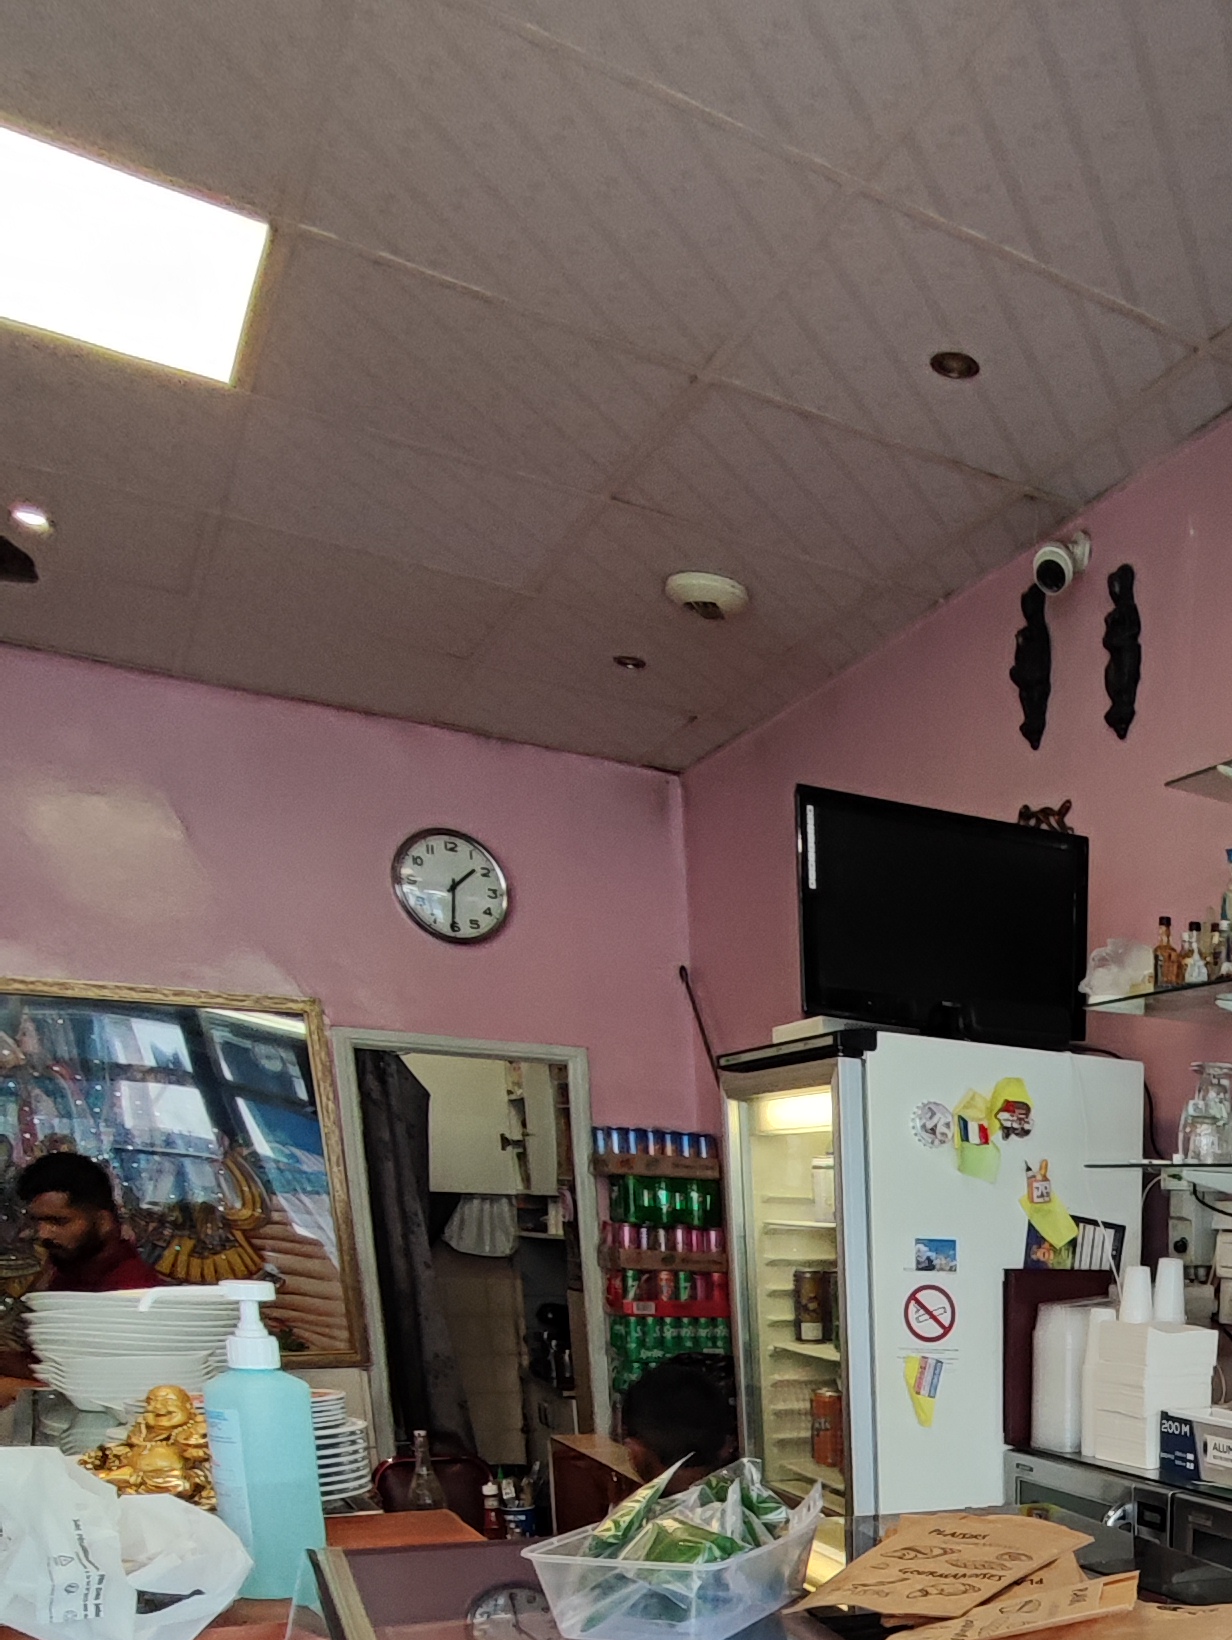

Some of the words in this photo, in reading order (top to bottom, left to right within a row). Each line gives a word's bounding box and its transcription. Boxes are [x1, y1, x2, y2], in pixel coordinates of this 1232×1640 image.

[426, 844, 435, 855] 11
[444, 841, 458, 853] 12
[412, 855, 424, 866] 10
[480, 867, 491, 878] 2
[487, 888, 498, 899] 3
[483, 907, 493, 916] 4
[450, 920, 461, 932] 6
[469, 919, 480, 930] 5
[1161, 1420, 1181, 1435] 200
[1181, 1424, 1190, 1438] M
